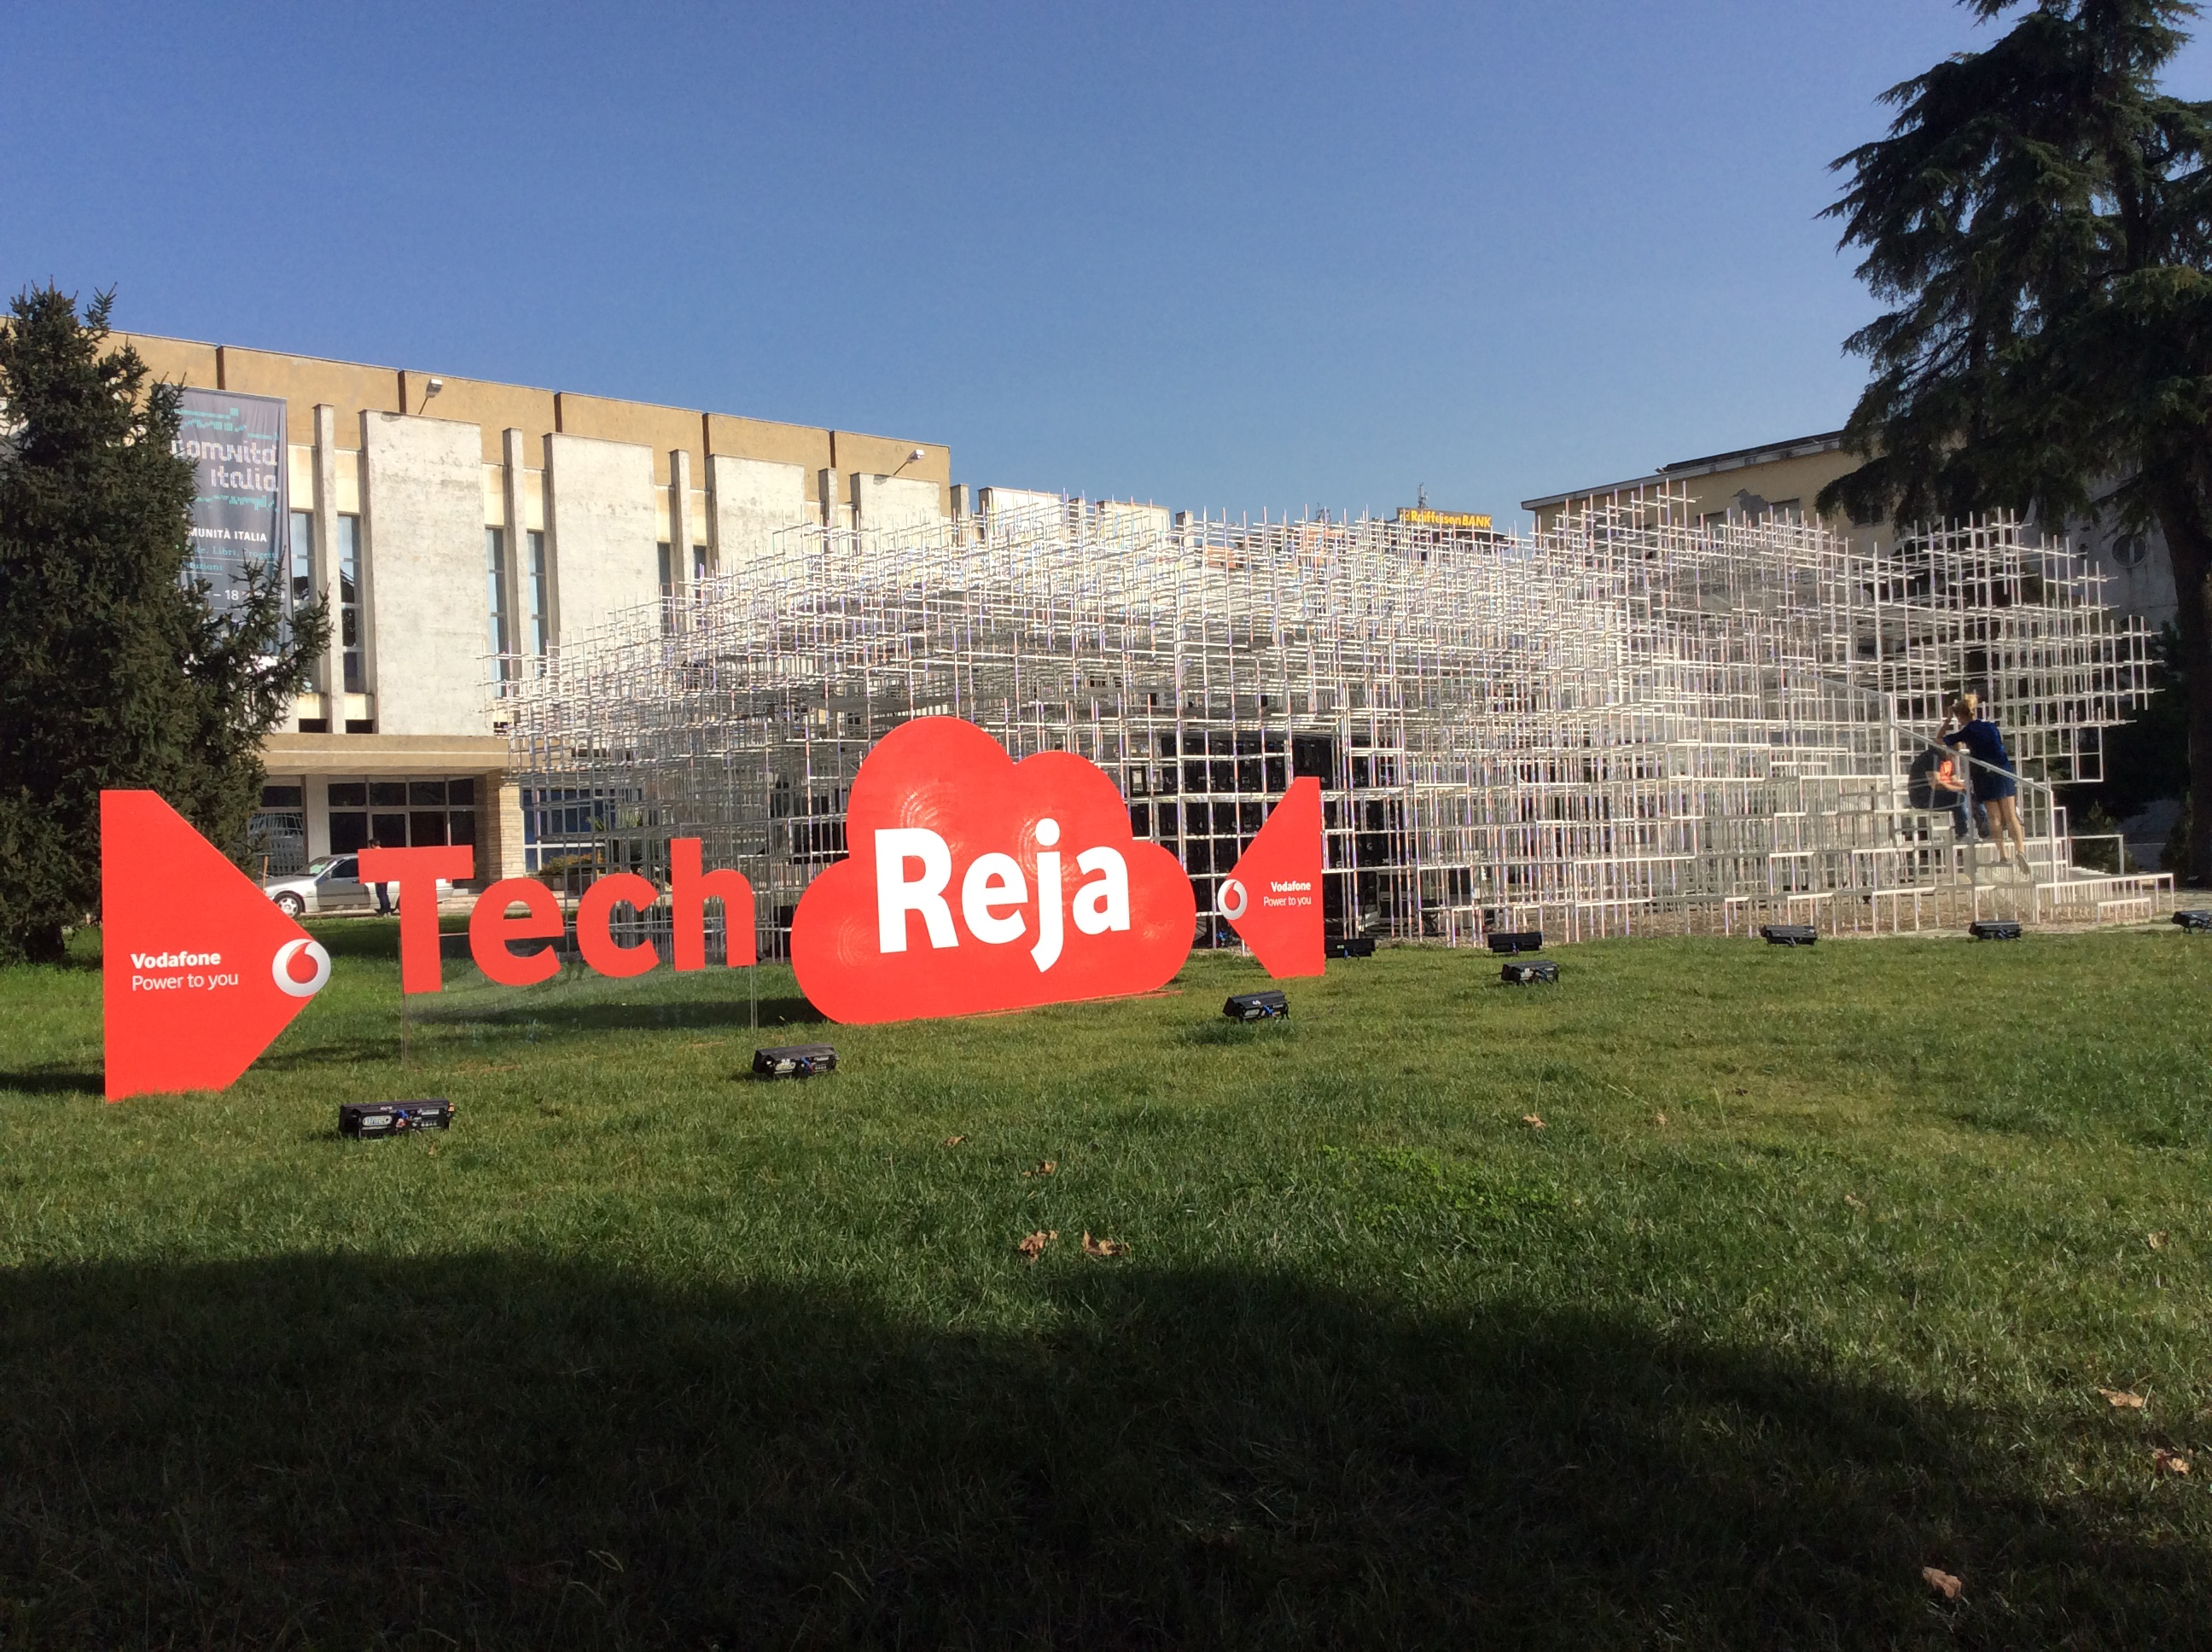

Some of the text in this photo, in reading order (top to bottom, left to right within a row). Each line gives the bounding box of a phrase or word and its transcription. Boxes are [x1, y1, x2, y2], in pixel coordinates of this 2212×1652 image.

[188, 527, 268, 543] MUNITÀ ITALIA
[224, 589, 239, 601] 18
[1270, 880, 1312, 893] Vodafone
[875, 817, 1131, 974] Reja
[1263, 896, 1312, 908] Power to you
[358, 838, 756, 994] Tech
[130, 951, 221, 969] Vodafone
[131, 973, 239, 992] Power to you
